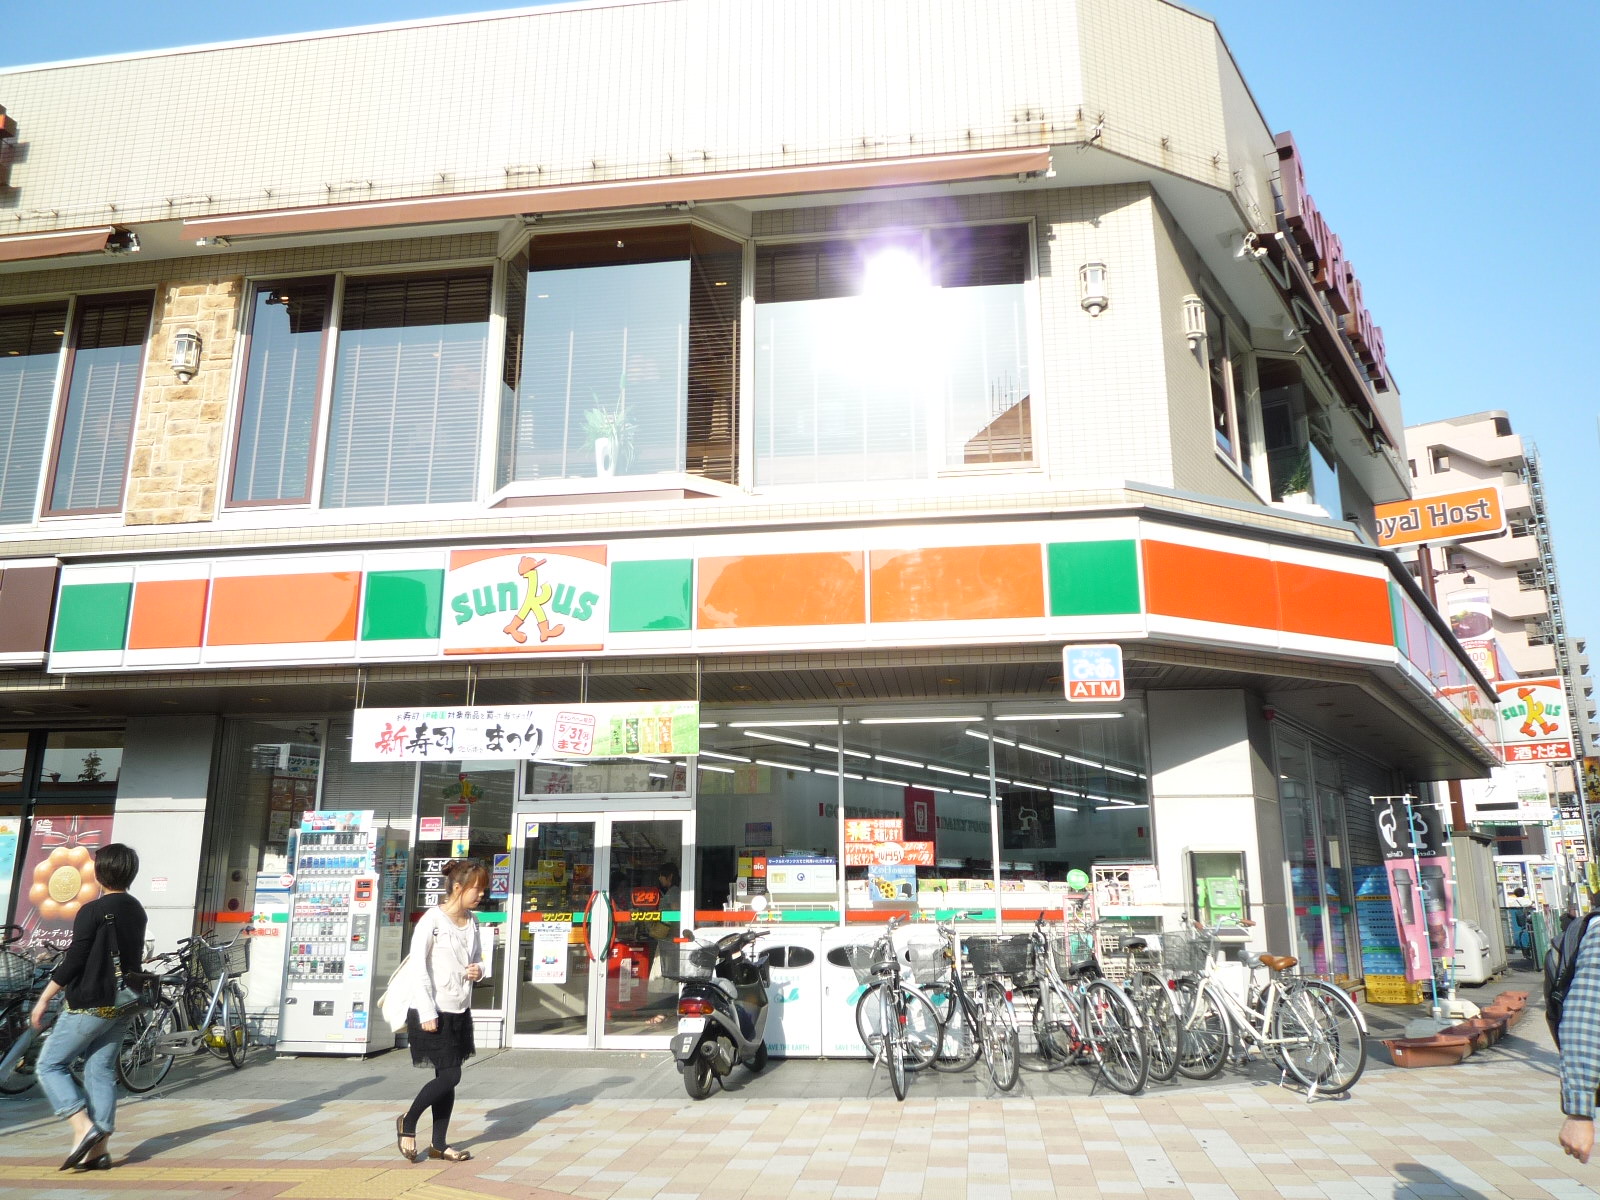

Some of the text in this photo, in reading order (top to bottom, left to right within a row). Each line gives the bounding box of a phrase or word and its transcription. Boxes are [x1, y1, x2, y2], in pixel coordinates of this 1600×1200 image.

[1427, 498, 1490, 527] Host
[1073, 681, 1117, 697] ATM
[485, 723, 543, 756] まつり
[631, 911, 661, 921] サンクス
